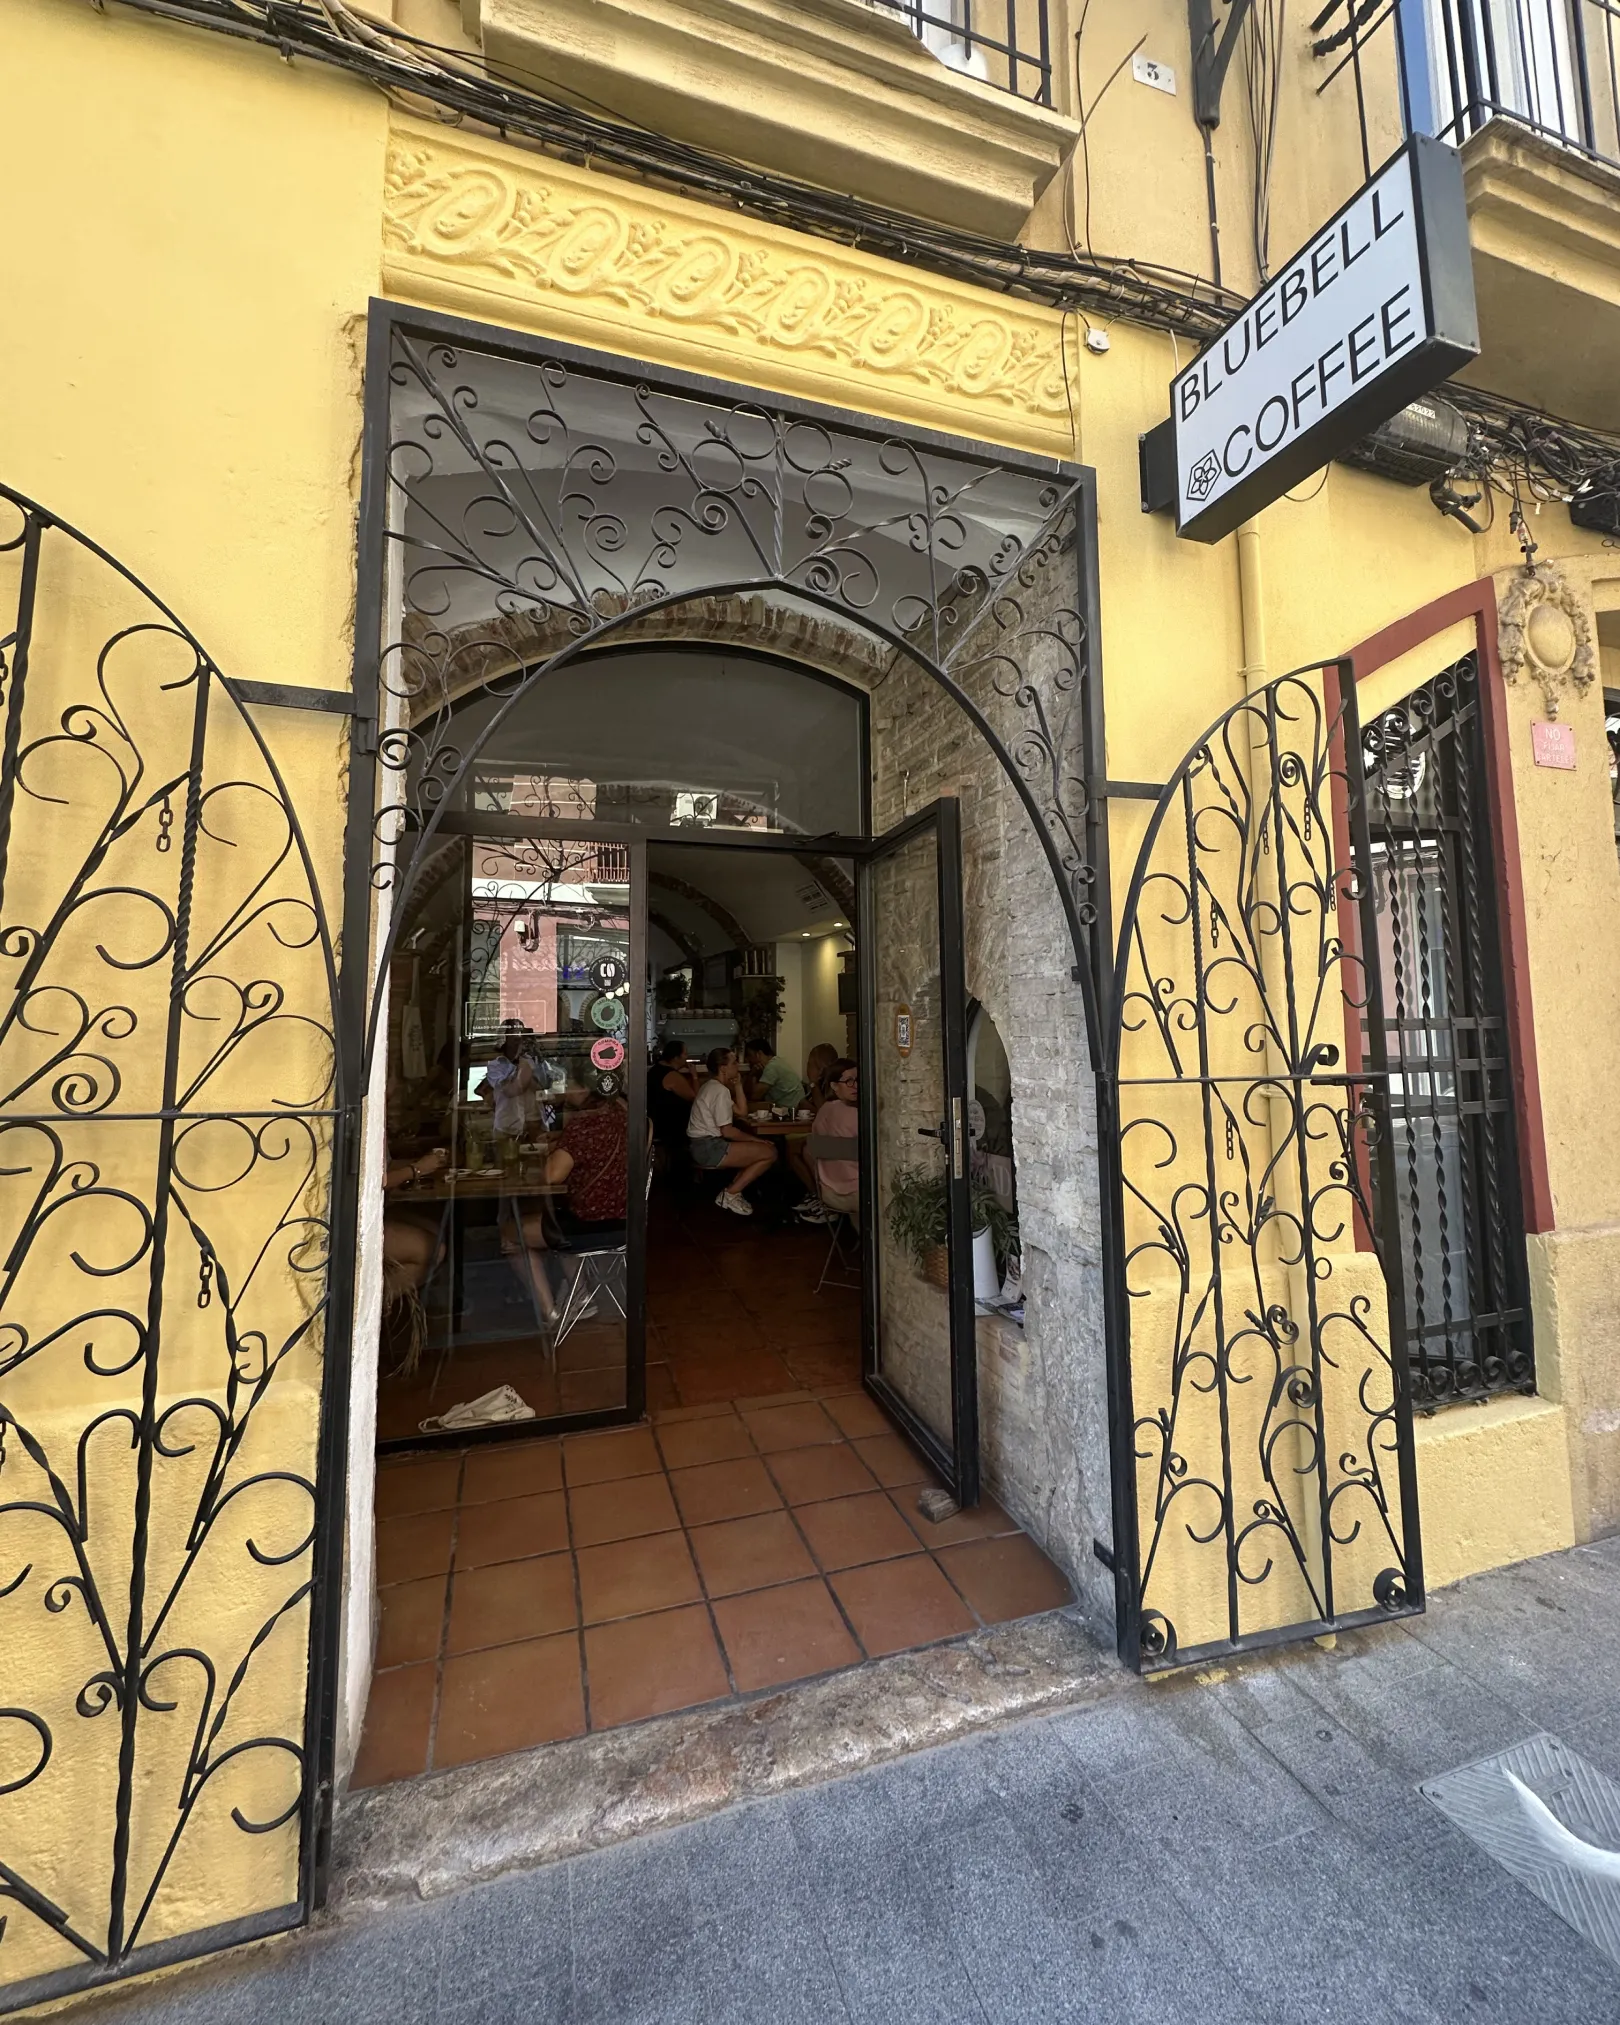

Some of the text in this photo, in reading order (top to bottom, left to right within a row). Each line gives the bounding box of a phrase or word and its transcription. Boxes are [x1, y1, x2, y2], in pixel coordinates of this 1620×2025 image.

[1147, 62, 1159, 81] 3
[1181, 189, 1404, 423] BLUEBELL
[1222, 284, 1415, 478] COFFEE
[1545, 728, 1560, 741] NO
[597, 1039, 619, 1047] COMPRA
